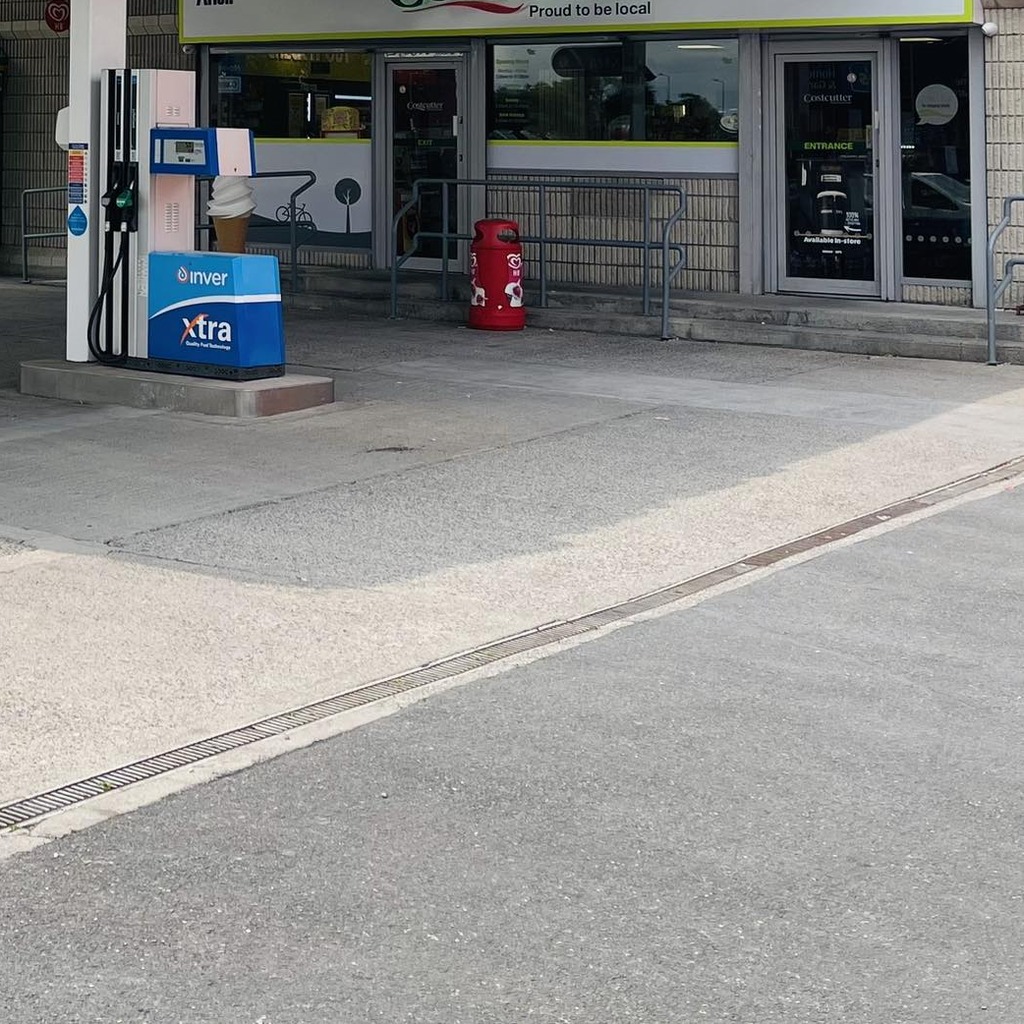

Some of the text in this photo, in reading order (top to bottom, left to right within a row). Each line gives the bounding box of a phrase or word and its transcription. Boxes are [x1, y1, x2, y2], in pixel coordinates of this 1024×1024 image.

[529, 1, 652, 18] Proud to be local
[803, 93, 853, 103] Costcutter
[804, 142, 854, 150] ENTRANCE
[803, 236, 835, 244] Available
[189, 271, 228, 286] inver
[181, 314, 231, 342] xtra
